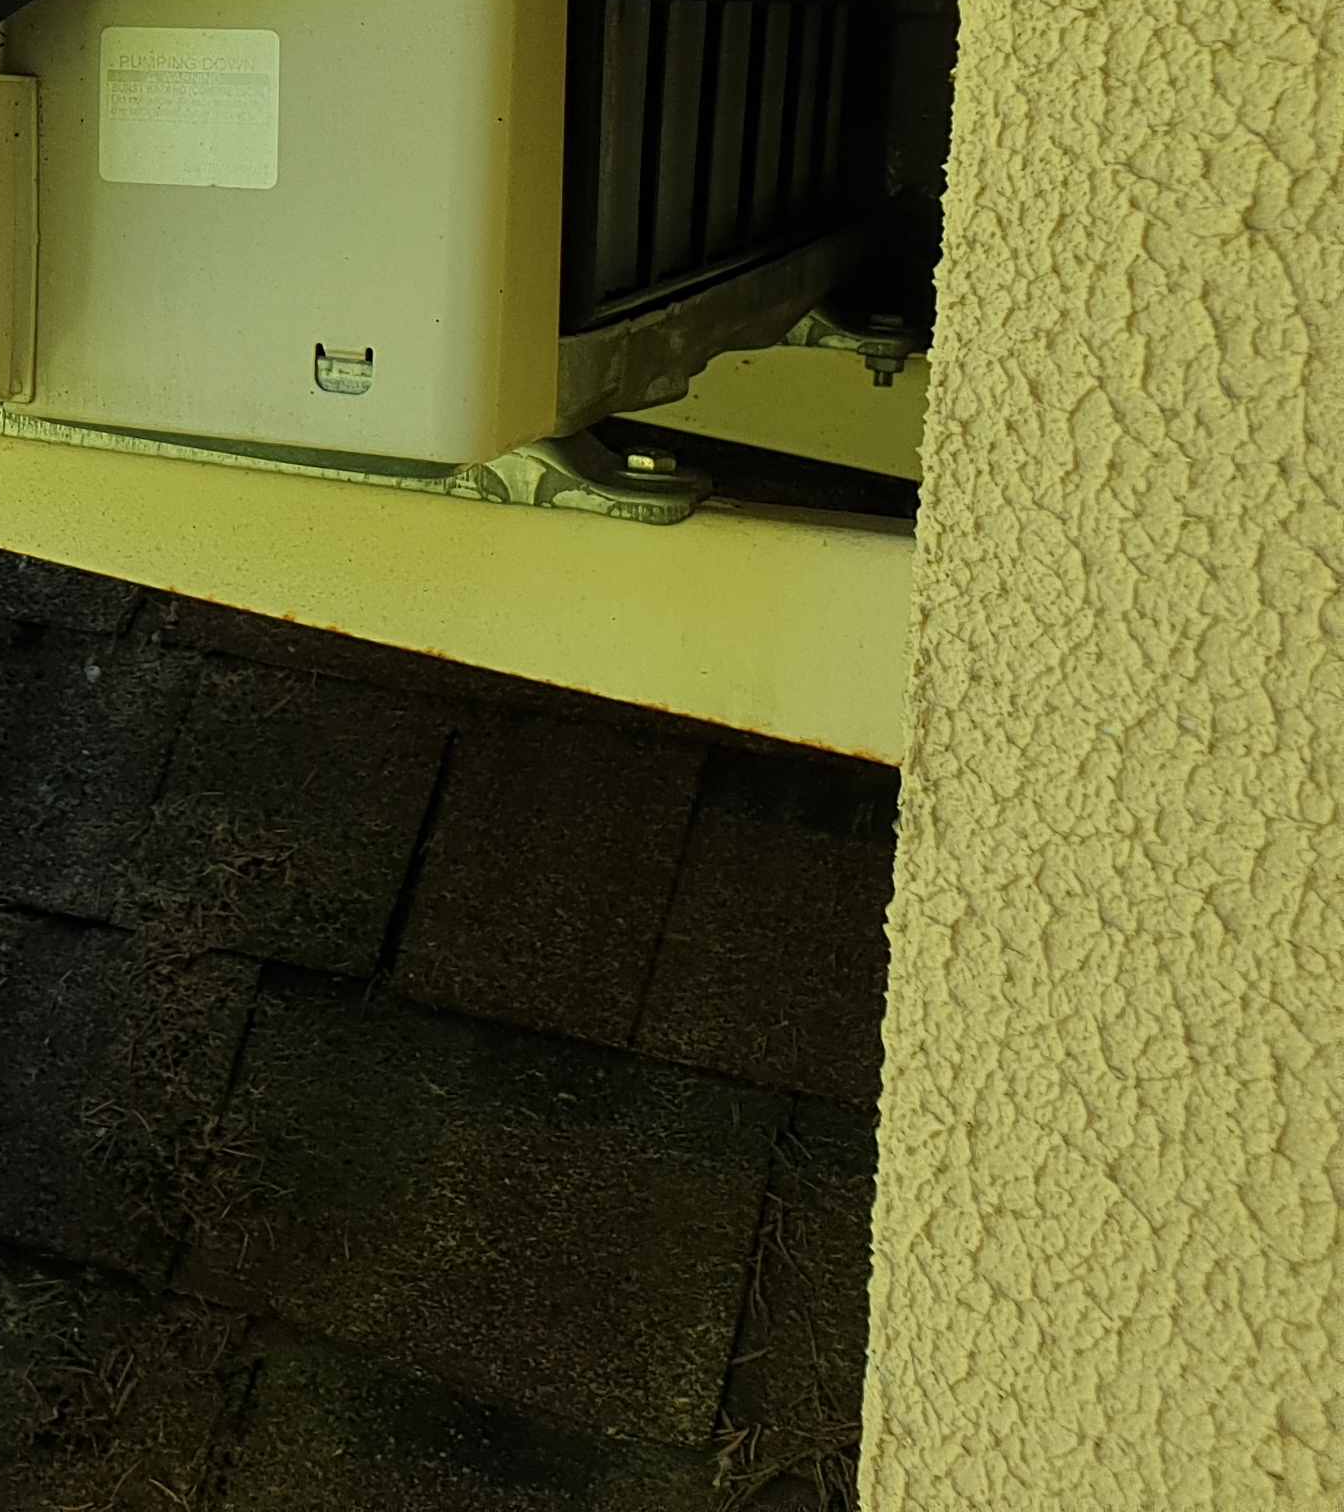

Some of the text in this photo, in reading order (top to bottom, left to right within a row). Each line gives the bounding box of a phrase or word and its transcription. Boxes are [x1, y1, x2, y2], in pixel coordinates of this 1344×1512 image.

[119, 55, 256, 72] PUMPING DOWN
[111, 83, 143, 93] BURST
